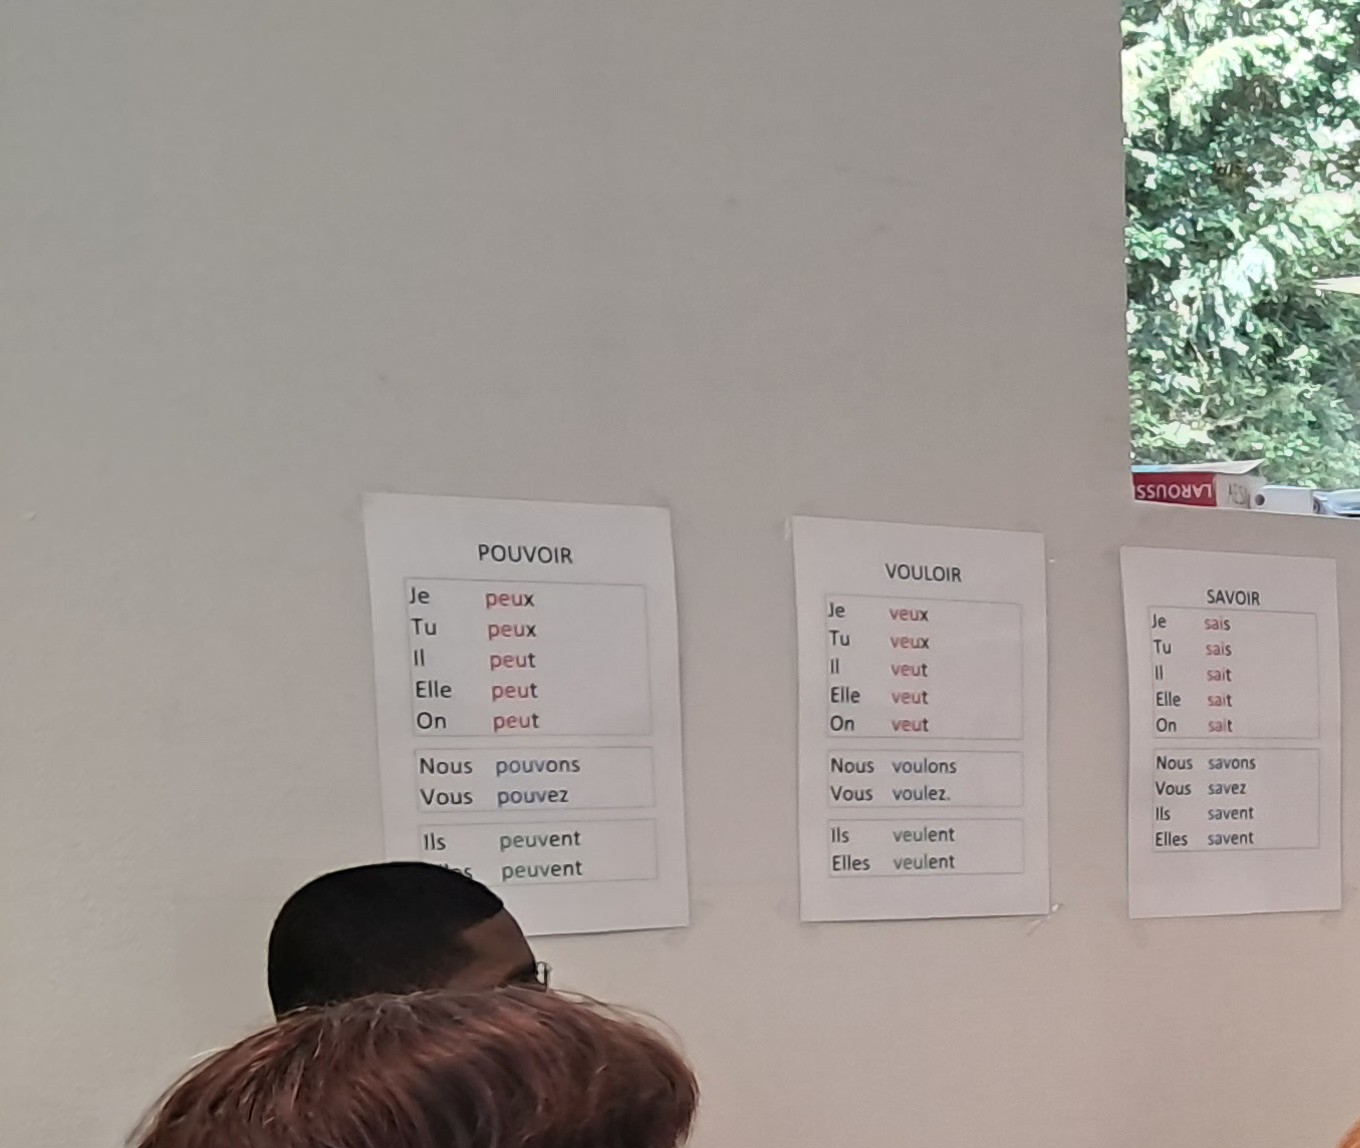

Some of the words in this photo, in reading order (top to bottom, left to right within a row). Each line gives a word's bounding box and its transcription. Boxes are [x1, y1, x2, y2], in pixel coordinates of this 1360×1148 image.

[1137, 483, 1213, 500] LAROUSS
[477, 543, 574, 565] POUVOIR
[884, 562, 963, 583] VOULOIR
[408, 586, 431, 605] Je
[485, 592, 535, 610] peux
[1206, 588, 1261, 606] SAVOIR
[827, 601, 846, 619] Je
[889, 608, 929, 622] veux
[410, 617, 437, 636] Tu
[487, 623, 537, 642] peux
[1150, 613, 1167, 629] Je
[1204, 618, 1231, 632] sais
[828, 629, 851, 647] Tu
[890, 636, 930, 650] veux
[1152, 638, 1172, 655] Tu
[1205, 644, 1233, 657] sais
[489, 652, 537, 672] peut
[890, 662, 929, 678] veut
[1206, 668, 1233, 683] sait
[415, 679, 452, 699] Elle
[491, 682, 539, 703] peut
[830, 685, 861, 704] Elle
[891, 690, 929, 705] veut
[1155, 690, 1182, 708] Elle
[1207, 693, 1233, 708] sait
[416, 711, 447, 730] On
[493, 712, 540, 733] peut
[829, 714, 855, 732] On
[891, 717, 930, 733] veut
[1155, 717, 1177, 733] On
[1207, 719, 1233, 733] sait
[419, 757, 473, 775] Nous
[495, 759, 581, 778] pouvons
[830, 757, 875, 774] Nous
[891, 757, 958, 774] voulons
[1155, 755, 1194, 771] Nous
[1207, 757, 1257, 771] savons
[829, 785, 874, 802] Vous
[1154, 780, 1192, 796] Vous
[1207, 782, 1247, 796] savez
[419, 787, 474, 806] Vous
[497, 789, 570, 809] pouvez
[1155, 805, 1171, 822] Ils
[1207, 806, 1254, 821] savent
[423, 831, 447, 851] Ils
[499, 830, 582, 853] peuvent
[830, 826, 850, 844] Ils
[892, 826, 956, 843] veulent
[1155, 830, 1189, 847] Elles
[1207, 831, 1255, 847] savent
[501, 860, 583, 883] peuvent
[832, 853, 871, 872] Elles
[892, 853, 956, 871] veulent
